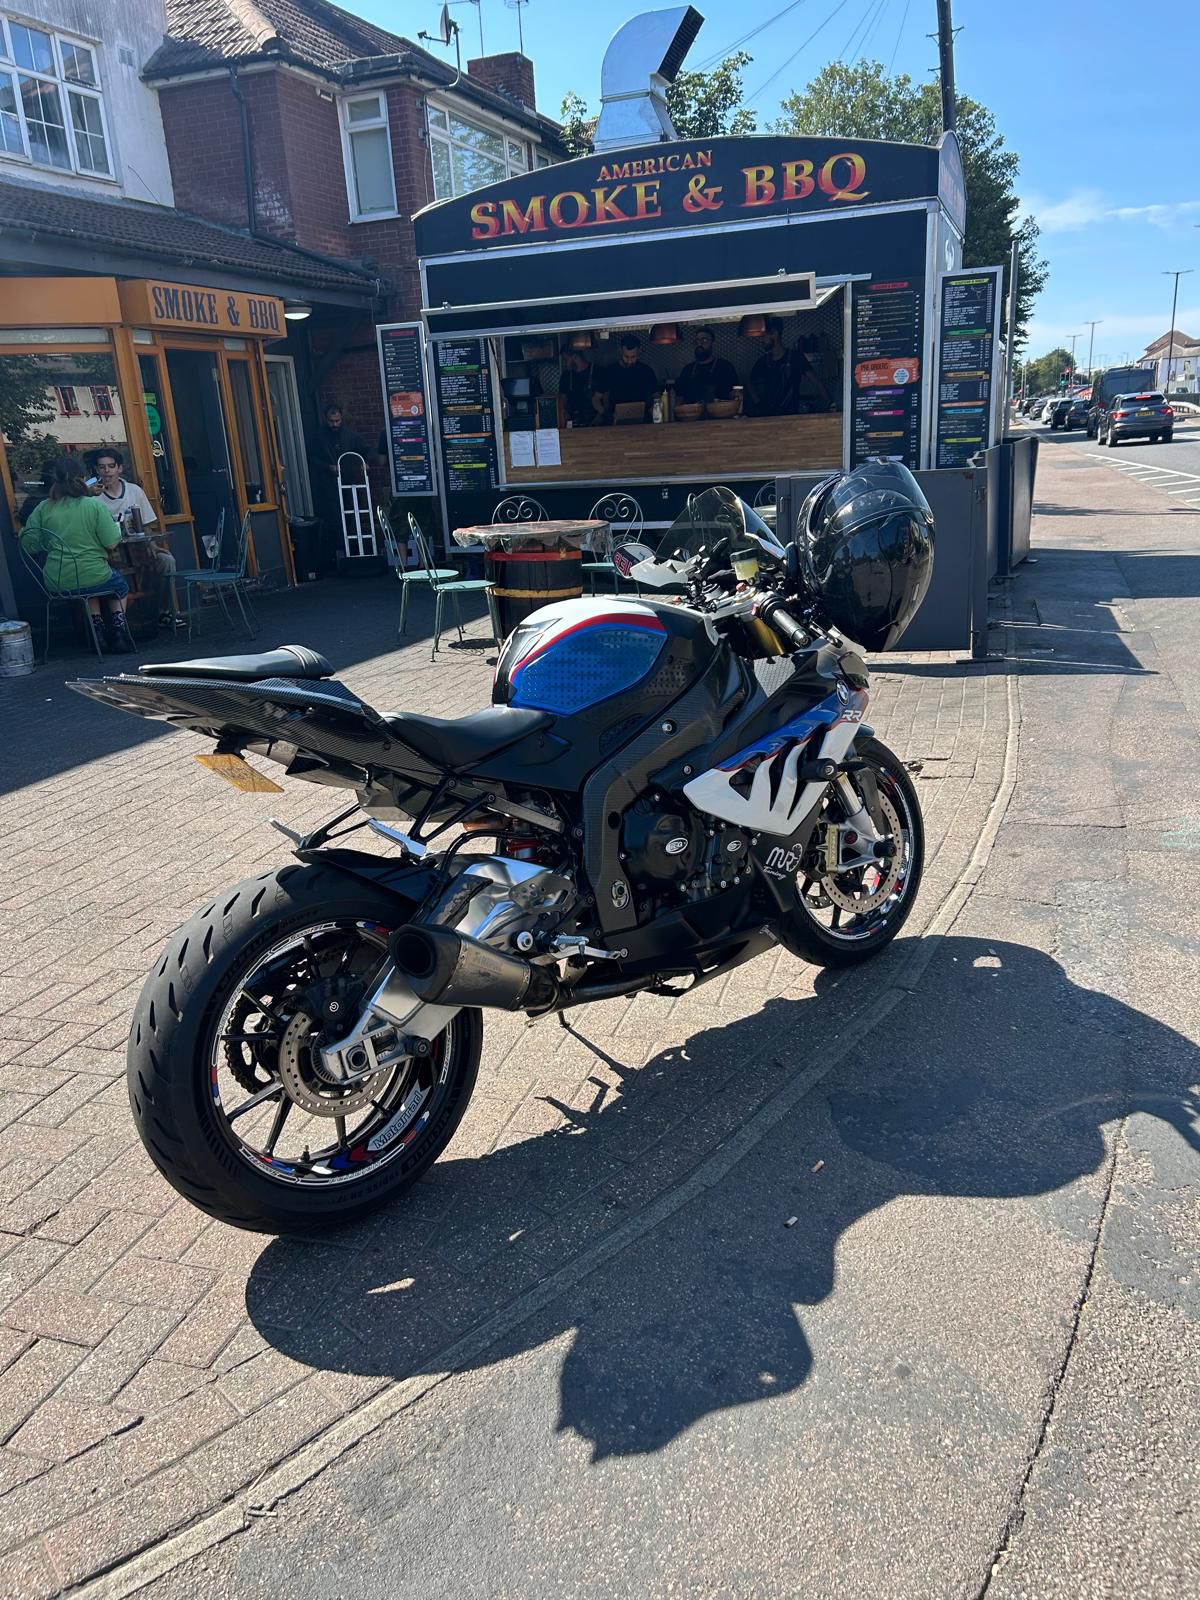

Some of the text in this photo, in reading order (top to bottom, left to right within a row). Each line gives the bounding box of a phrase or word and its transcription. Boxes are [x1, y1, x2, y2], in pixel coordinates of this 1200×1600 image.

[597, 150, 712, 182] AMERICAN
[470, 152, 871, 240] SMOKE & BBQ
[152, 286, 280, 332] SMOKE & BBQ
[842, 709, 862, 721] RR
[374, 1090, 423, 1149] Motorrad
